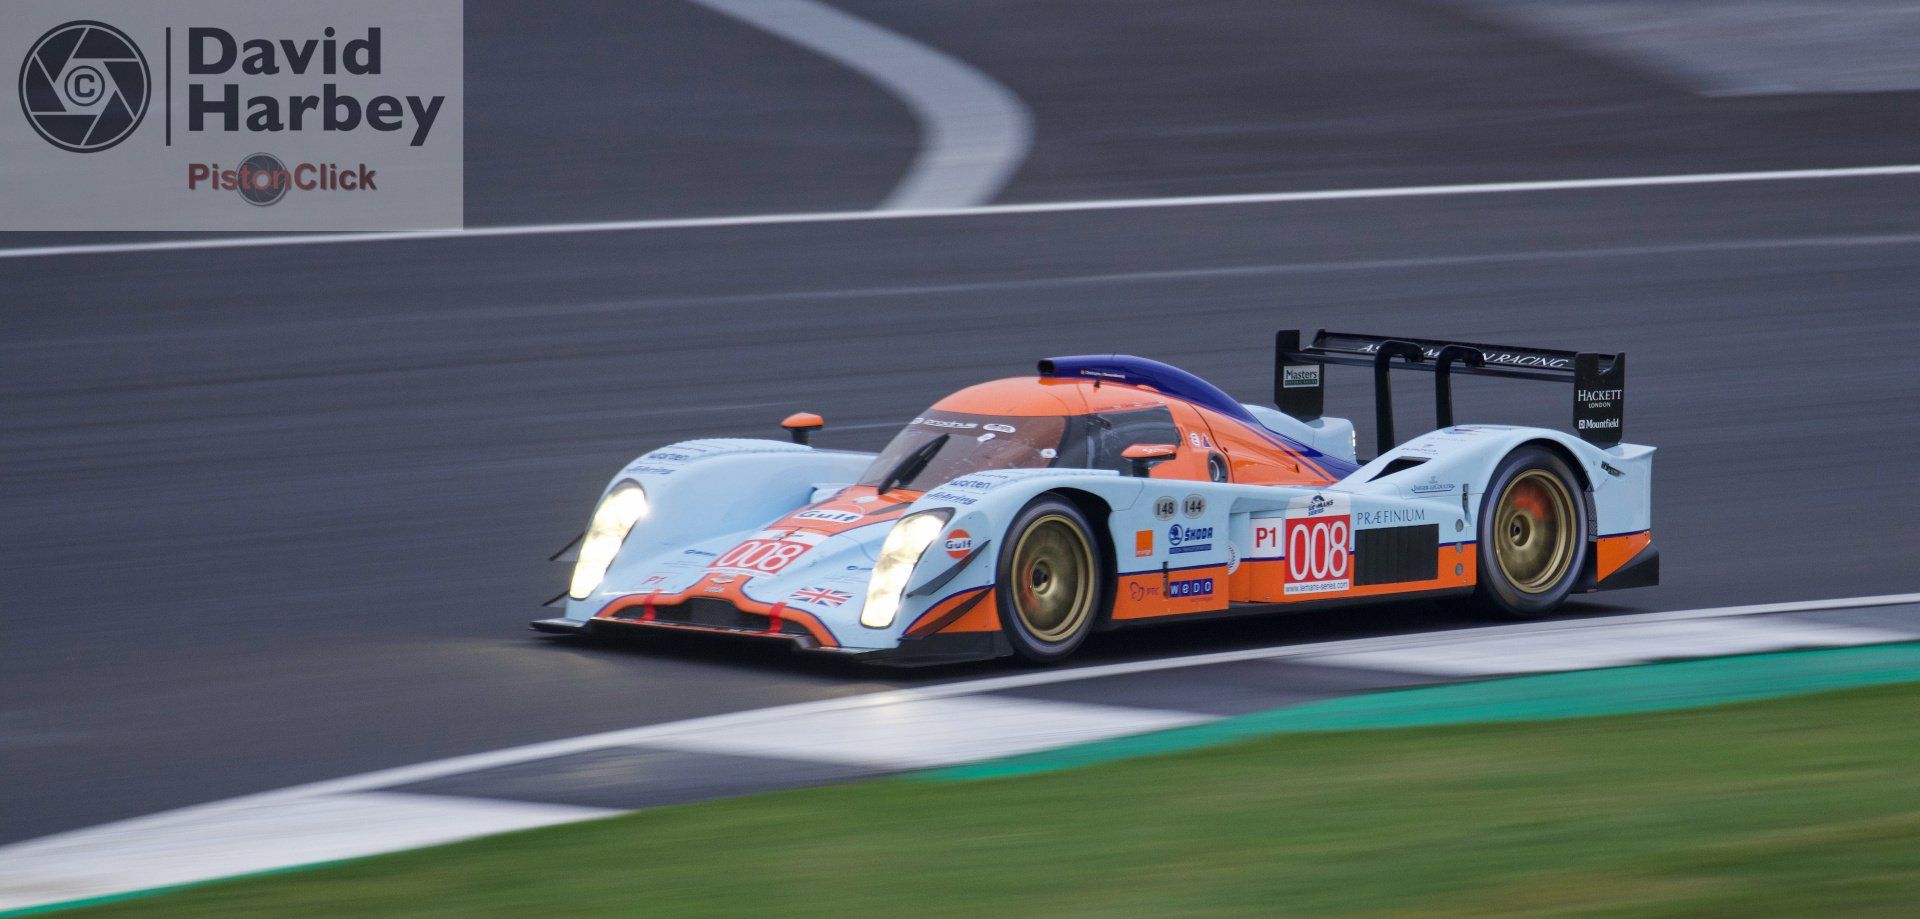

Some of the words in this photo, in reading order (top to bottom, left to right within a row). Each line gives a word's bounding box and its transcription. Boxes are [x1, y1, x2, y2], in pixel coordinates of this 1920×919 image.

[1494, 353, 1569, 368] RACING
[1286, 370, 1318, 380] Masters
[1577, 389, 1622, 402] HACKETT
[1586, 418, 1619, 429] Mountfield
[950, 480, 991, 489] worten
[1157, 502, 1175, 515] 148
[1185, 500, 1202, 513] 144
[800, 509, 861, 522] Gulf
[1256, 527, 1277, 548] P1
[945, 540, 973, 550] Gulf
[1289, 520, 1348, 581] 008
[716, 540, 804, 572] 008
